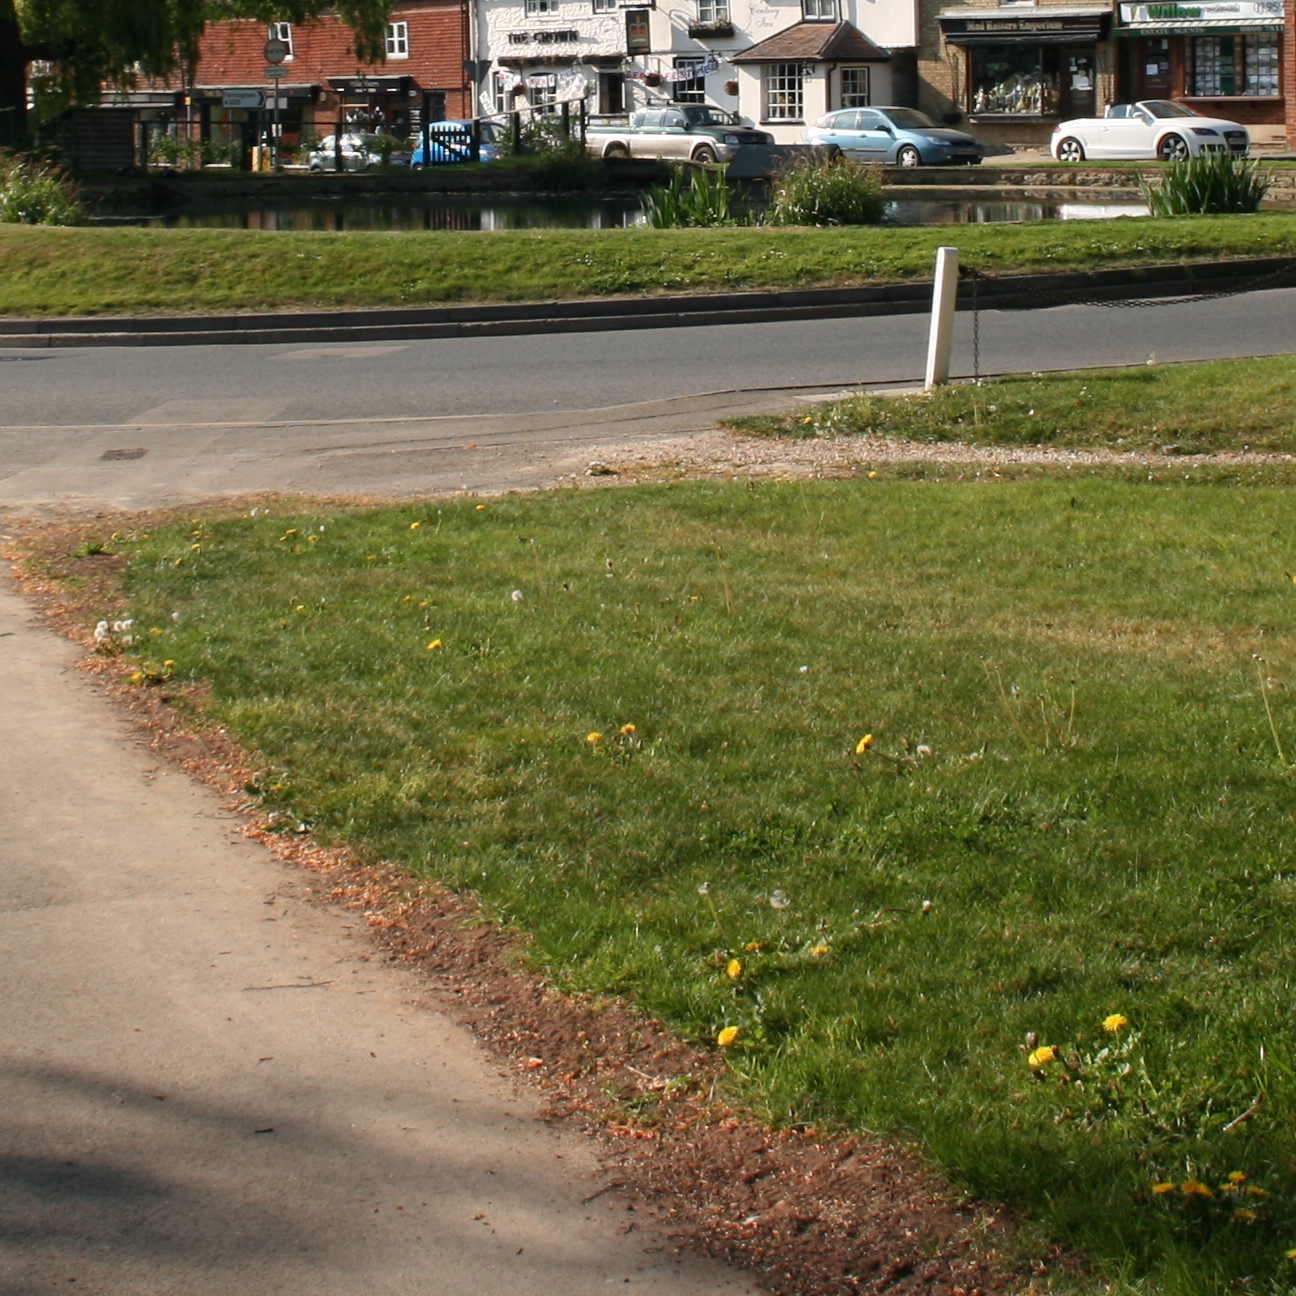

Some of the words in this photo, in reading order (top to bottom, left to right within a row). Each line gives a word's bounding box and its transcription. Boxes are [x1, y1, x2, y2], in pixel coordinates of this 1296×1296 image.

[1147, 3, 1201, 19] Willow
[508, 32, 529, 45] THE
[533, 29, 578, 44] CROWN
